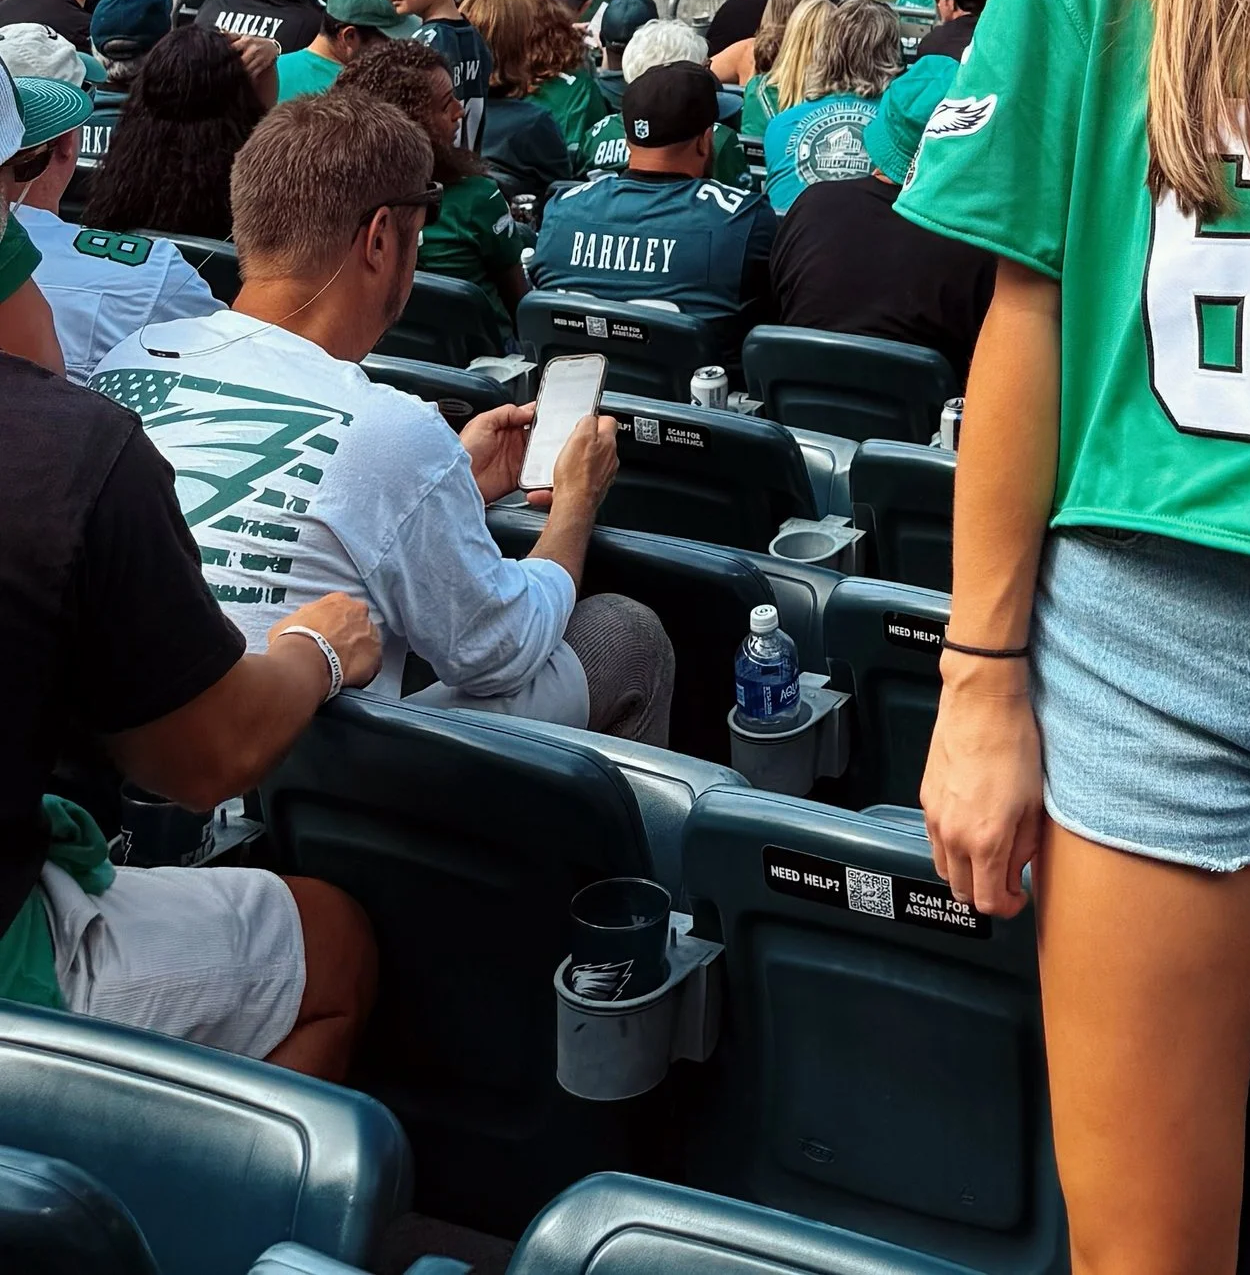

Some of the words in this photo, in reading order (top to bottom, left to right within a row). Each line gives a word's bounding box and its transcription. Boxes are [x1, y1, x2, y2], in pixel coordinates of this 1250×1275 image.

[215, 10, 283, 39] BARKLEY
[570, 232, 676, 273] BARKLEY
[665, 435, 705, 448] ASSISTANCE
[667, 428, 685, 437] SCAN
[686, 431, 701, 440] FOR
[889, 624, 911, 637] NEED
[913, 630, 941, 644] HELP?
[770, 864, 800, 883] NEED
[803, 871, 840, 892] HELP?
[909, 891, 942, 909] SCAN
[945, 898, 971, 915] FOR
[904, 903, 976, 928] ASSISTANCE
